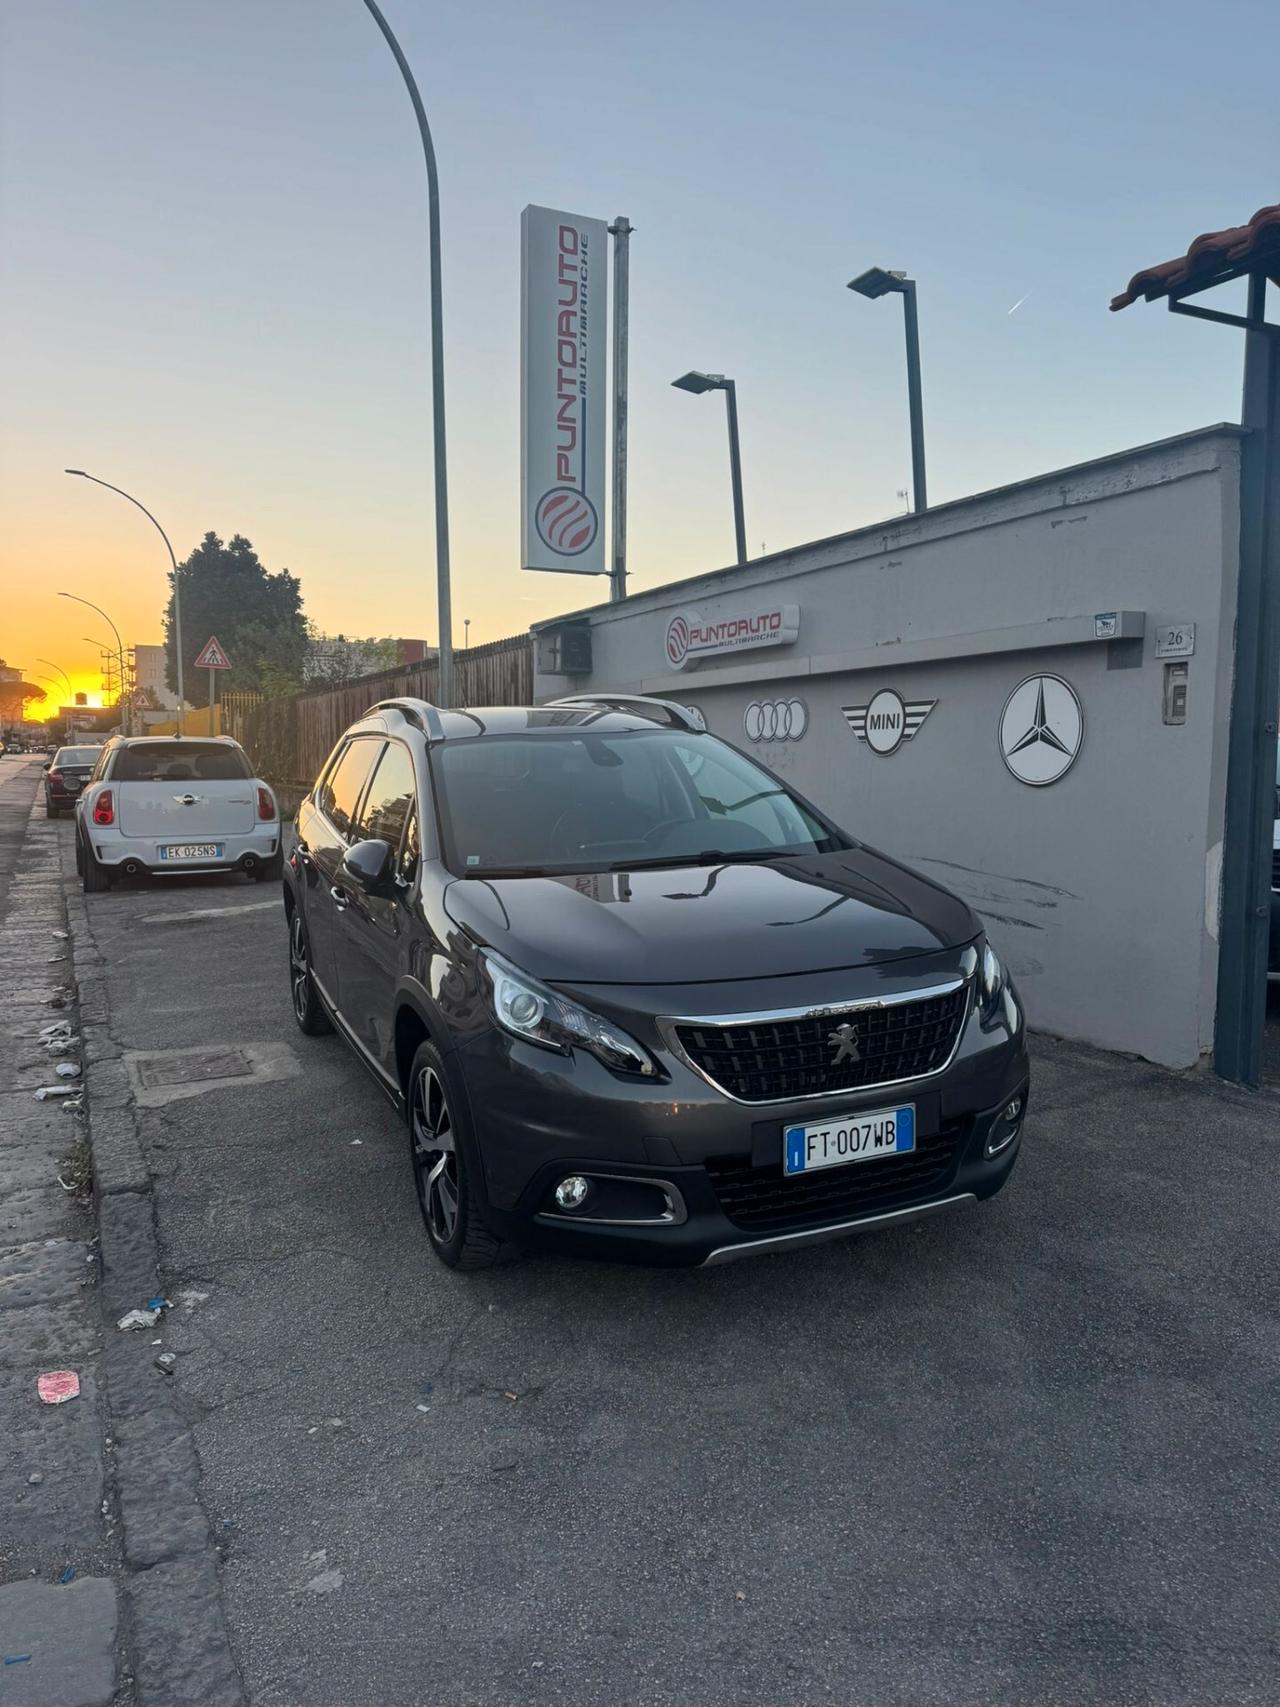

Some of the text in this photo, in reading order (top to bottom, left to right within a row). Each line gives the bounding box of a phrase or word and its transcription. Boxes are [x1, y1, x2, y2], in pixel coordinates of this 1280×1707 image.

[579, 232, 589, 396] MULTIMARCHE
[557, 225, 578, 483] PUNTOAUTO
[690, 612, 781, 645] PUNTOAUTO
[1168, 632, 1182, 645] 26
[870, 713, 900, 730] MINI
[168, 844, 216, 858] EK 025NS
